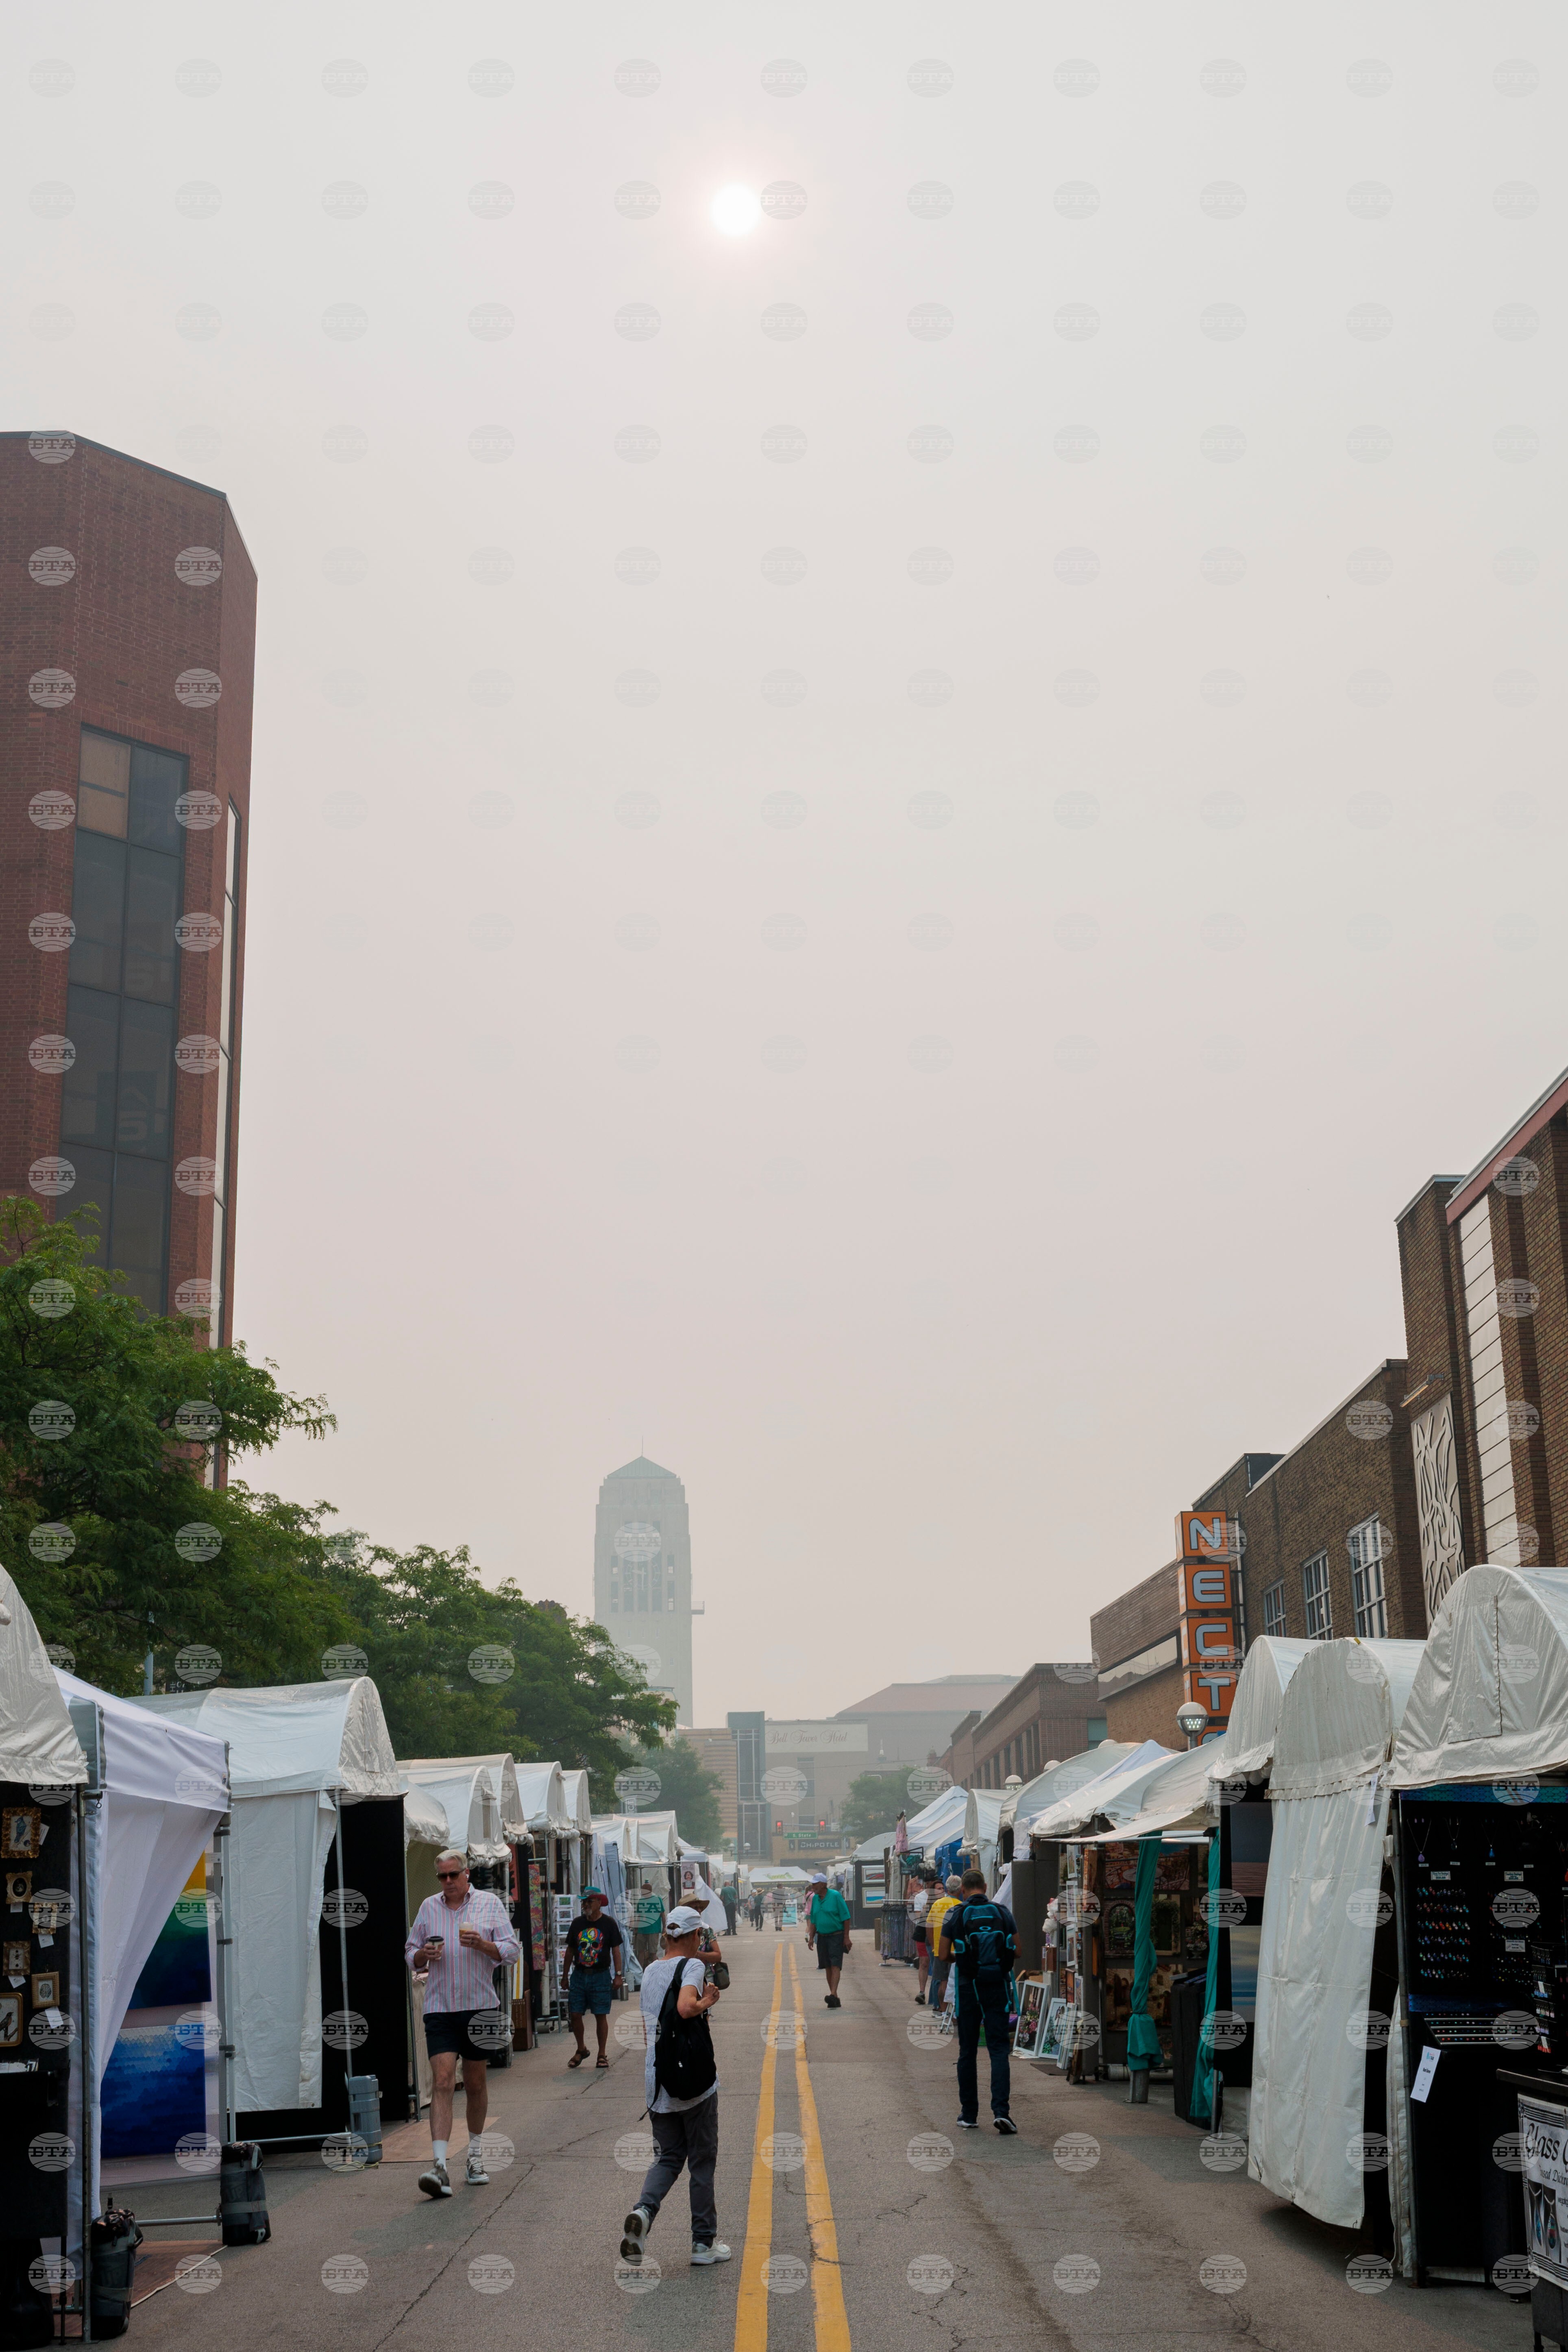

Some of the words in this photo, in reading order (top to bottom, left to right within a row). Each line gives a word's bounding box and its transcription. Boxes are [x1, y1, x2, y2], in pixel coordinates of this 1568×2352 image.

[765, 1729, 787, 1744] Bell
[791, 1730, 818, 1744] Tower
[820, 1729, 848, 1744] Hotel
[1525, 2123, 1560, 2161] Glass
